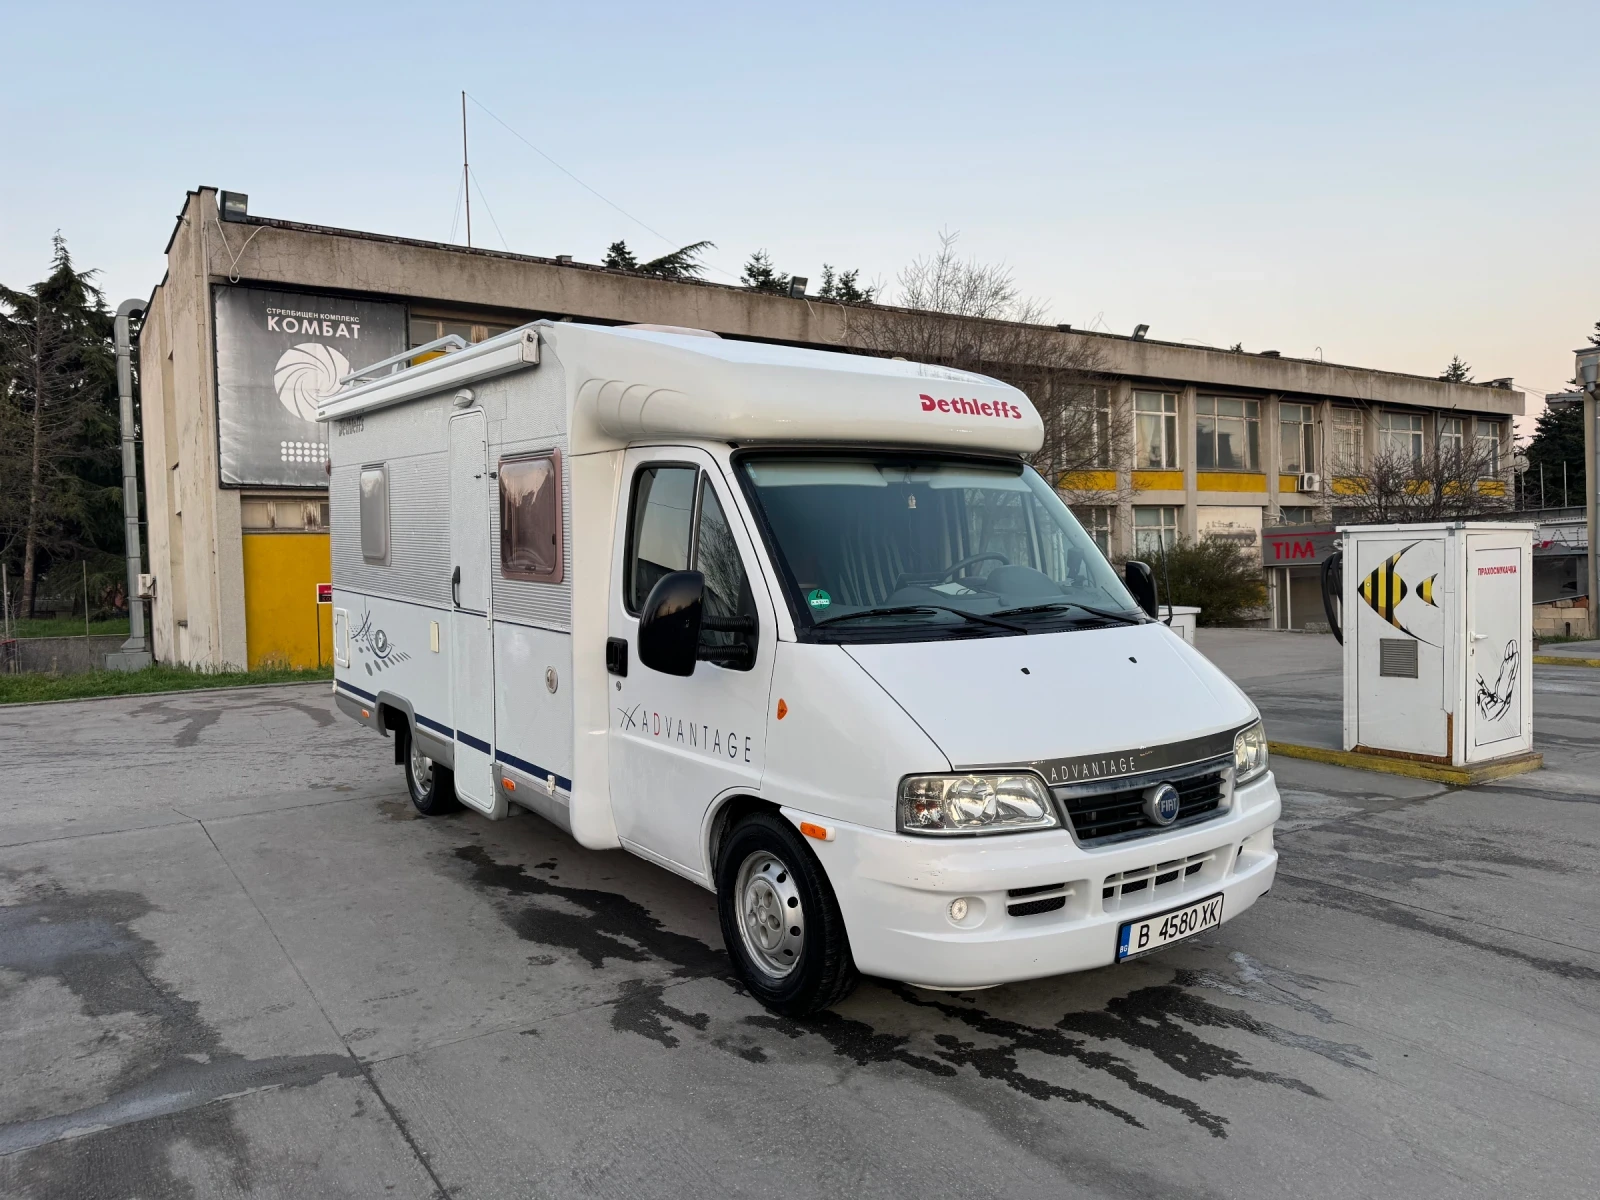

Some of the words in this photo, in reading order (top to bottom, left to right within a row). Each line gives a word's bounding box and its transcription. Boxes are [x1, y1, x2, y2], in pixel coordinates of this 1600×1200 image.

[267, 315, 361, 339] КОМБАТ
[320, 313, 360, 323] КОМПЛЕКС
[918, 393, 1022, 419] Dethleffs
[1272, 541, 1316, 560] TIM
[641, 710, 751, 762] ADVANTAGE
[1051, 756, 1136, 781] ADVANTAGE
[1160, 798, 1178, 813] FIAT
[1137, 923, 1150, 949] B
[1158, 908, 1198, 941] 4580
[1199, 899, 1220, 928] XK
[1119, 944, 1128, 953] BG
